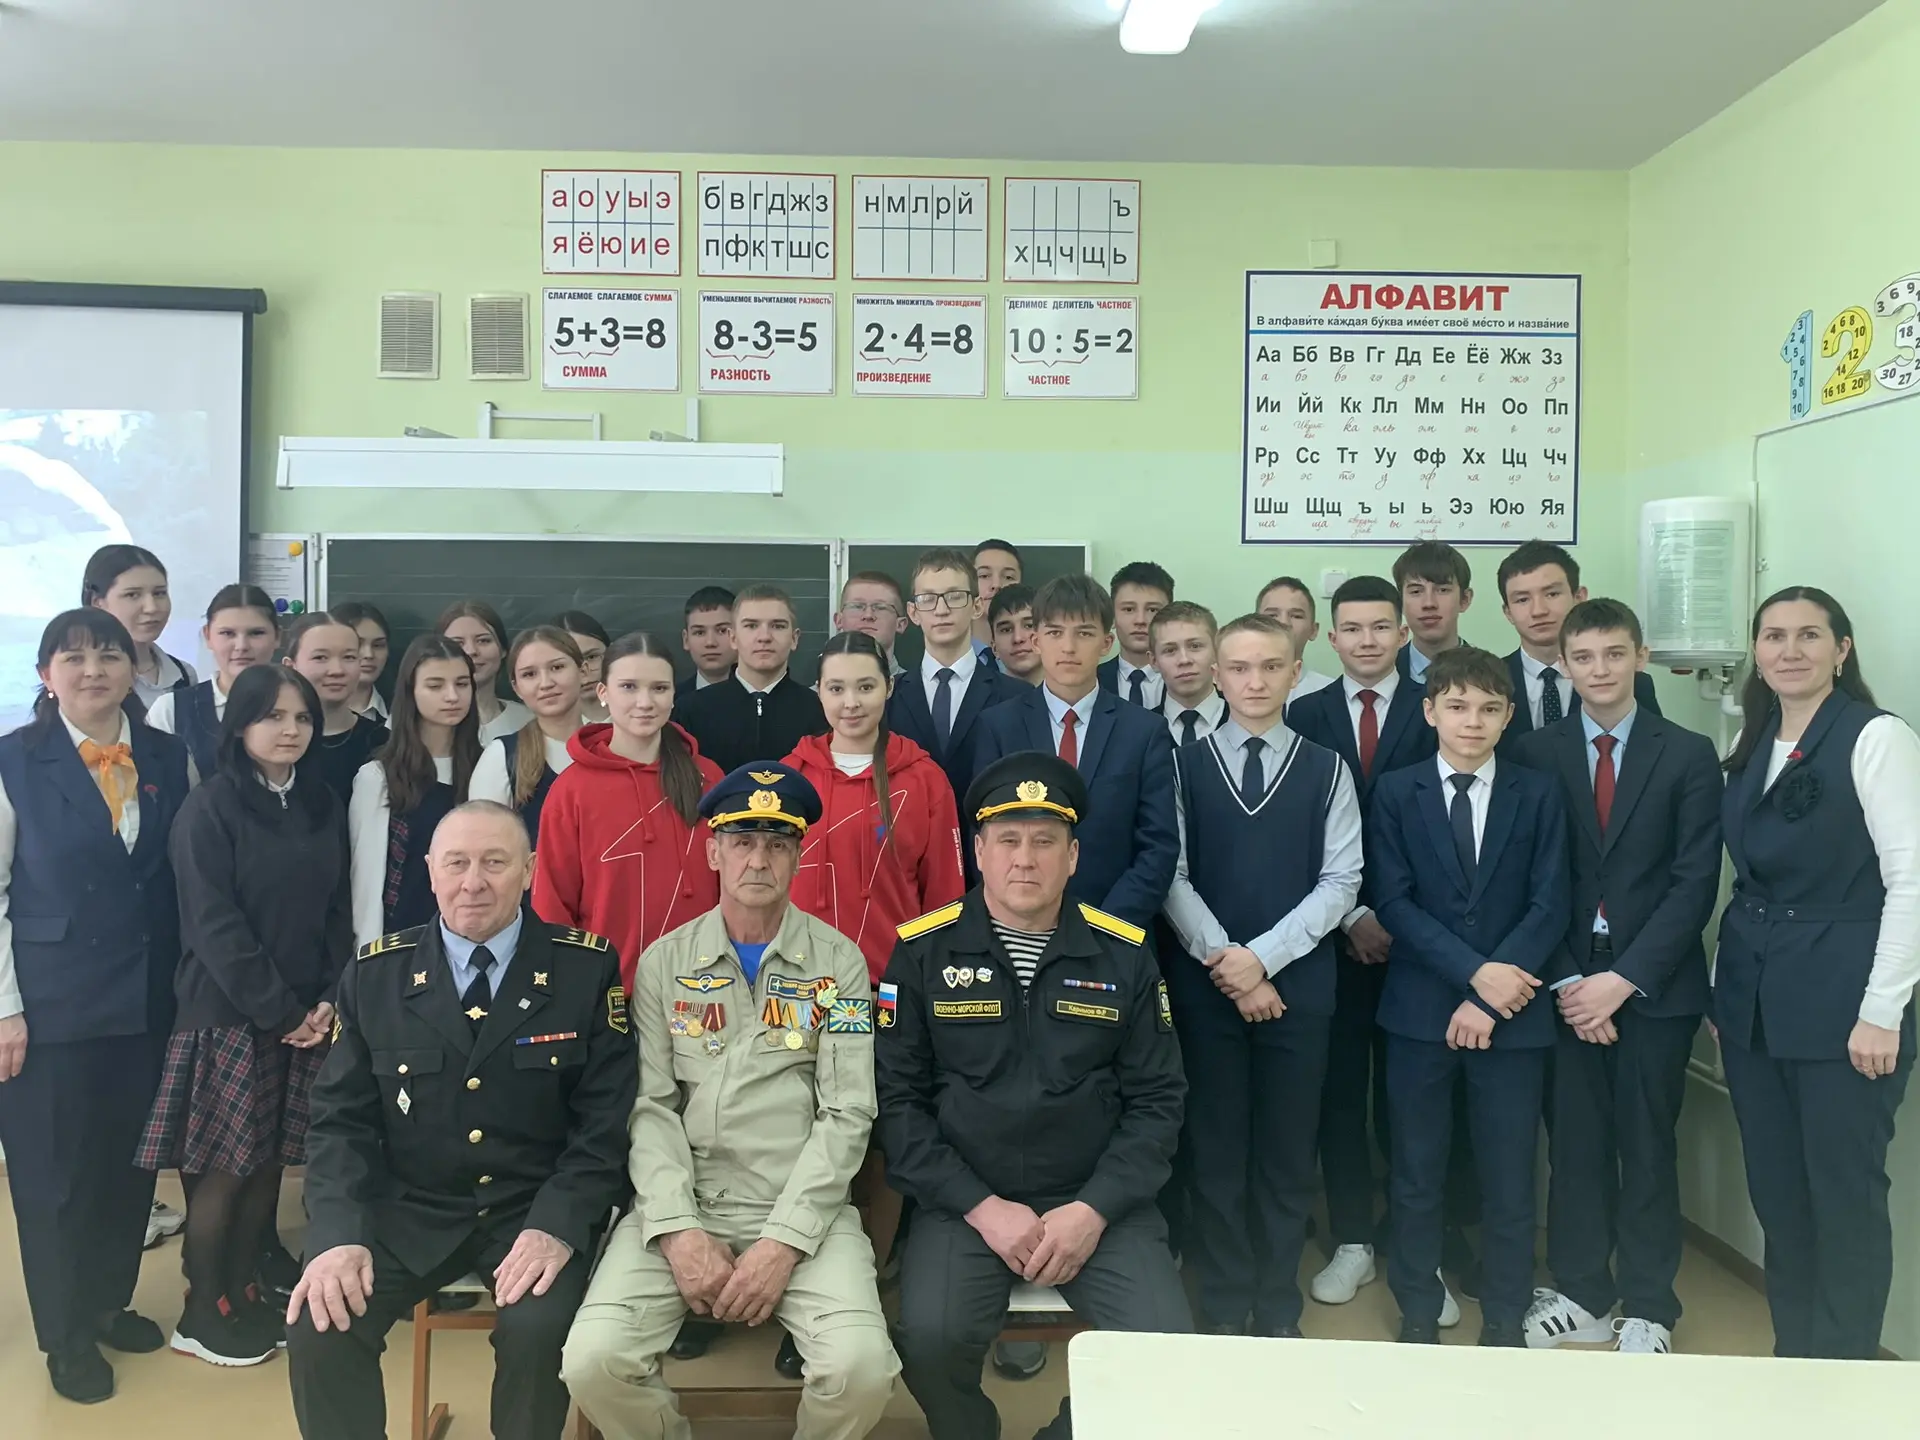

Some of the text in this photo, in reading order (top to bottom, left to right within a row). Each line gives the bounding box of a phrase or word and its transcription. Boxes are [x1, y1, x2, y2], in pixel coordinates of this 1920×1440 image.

[552, 190, 671, 213] а о у ы э
[704, 186, 828, 215] б в г д ж з
[866, 192, 973, 220] н м л р й
[552, 232, 670, 255] я ё ю и е
[706, 234, 829, 262] п ф к т ш с
[1014, 246, 1127, 268] х ц ч щ ь
[548, 292, 673, 302] СЛАГАЕМОЕ СЛАГАЕМОЕ СУММА
[702, 295, 752, 303] УМЕНЬШАЕМОЕ
[754, 296, 797, 304] ВЫЧИТАЕМОЕ
[856, 298, 895, 306] МНОЖИТЕЛЬ
[1009, 300, 1132, 310] ДЕЛИМОЕ ДЕЛИТЕЛЬ ЧАСТНОЕ
[1320, 284, 1510, 311] АЛФАВИТ
[1257, 316, 1265, 325] В
[1443, 318, 1469, 327] своё
[554, 317, 667, 349] 5+3=8
[714, 320, 818, 352] 8-3=5
[1256, 343, 1563, 366] Аа Бб Вв Гг Дд Ее Ёё Жж Зз
[563, 366, 607, 378] СУММА
[710, 369, 771, 381] РАЗНОСТЬ
[856, 372, 931, 383] ПРОИЗВЕДЕНИЕ
[1028, 375, 1070, 385] ЧАСТНОЕ
[1257, 392, 1568, 415] Ии Йй Кк Лл Мм Нн Оо Пп
[1256, 447, 1566, 468] Рр Сс Тт Уу Фф Хх Цц Чч
[1255, 498, 1565, 517] Шш Щщ ъ ы ь Ээ Юю Яя
[984, 1004, 999, 1013] ФЛОТ
